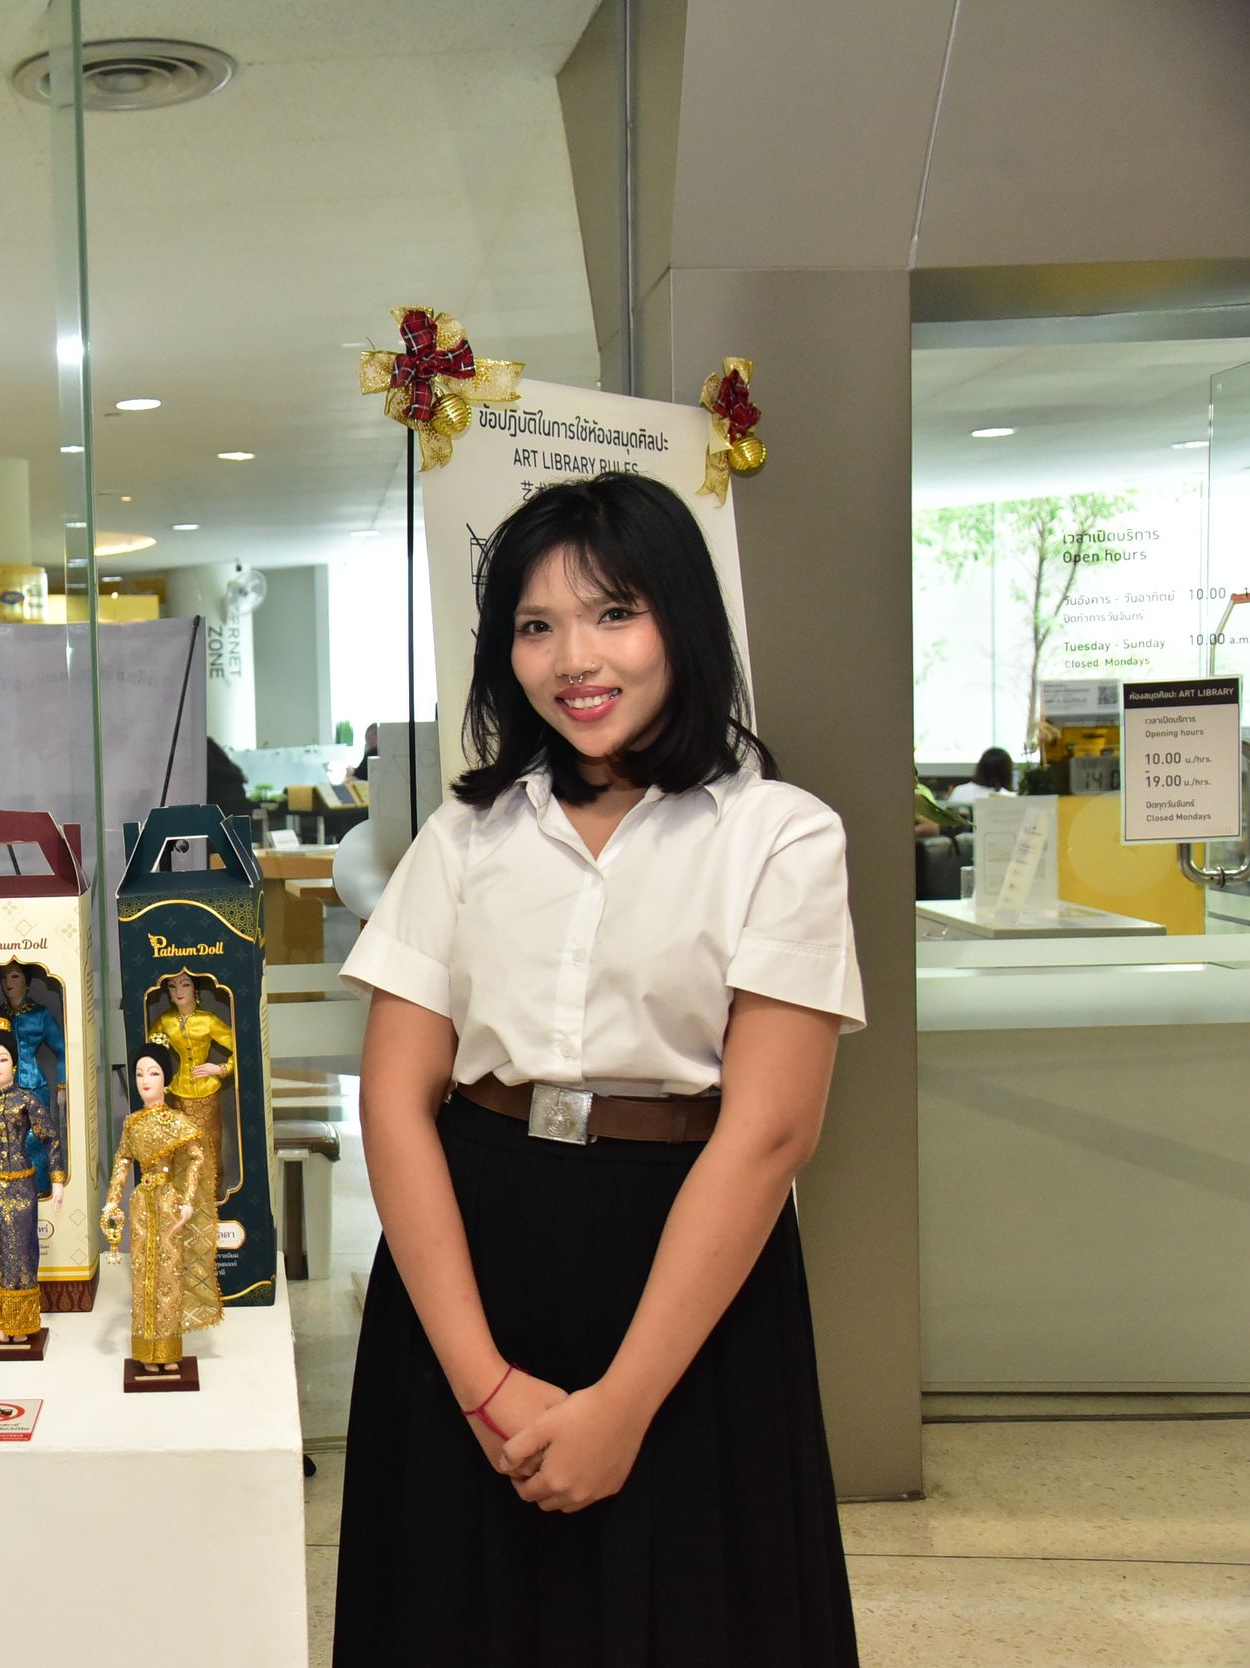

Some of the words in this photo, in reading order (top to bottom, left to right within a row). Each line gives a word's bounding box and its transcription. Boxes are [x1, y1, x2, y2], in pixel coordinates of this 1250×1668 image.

[479, 404, 669, 455] ข้อปฏิบัติในการใช้ห้องสมุดศิลปะ
[513, 448, 538, 468] ART
[542, 452, 596, 475] LIBRARY
[1063, 528, 1160, 544] เวลาเปิดบริการ
[1062, 550, 1100, 565] Open
[1104, 548, 1147, 562] hours
[1189, 587, 1226, 600] 10.00
[1063, 640, 1111, 652] Tuesday
[1123, 638, 1166, 650] Sunday
[1189, 632, 1226, 646] 10.00
[207, 625, 225, 680] ZONE
[1064, 659, 1099, 669] Closed
[1104, 656, 1151, 668] Mondays
[1178, 689, 1195, 698] ART
[1197, 687, 1235, 697] LIBRARY
[1145, 729, 1179, 739] Opening
[1145, 752, 1182, 765] 10.00
[1145, 774, 1182, 788] 19.00
[1146, 814, 1174, 822] Closed
[1176, 812, 1212, 822] Mondays
[21, 937, 48, 950] Doll
[148, 933, 198, 958] Pathum
[198, 941, 224, 956] Doll
